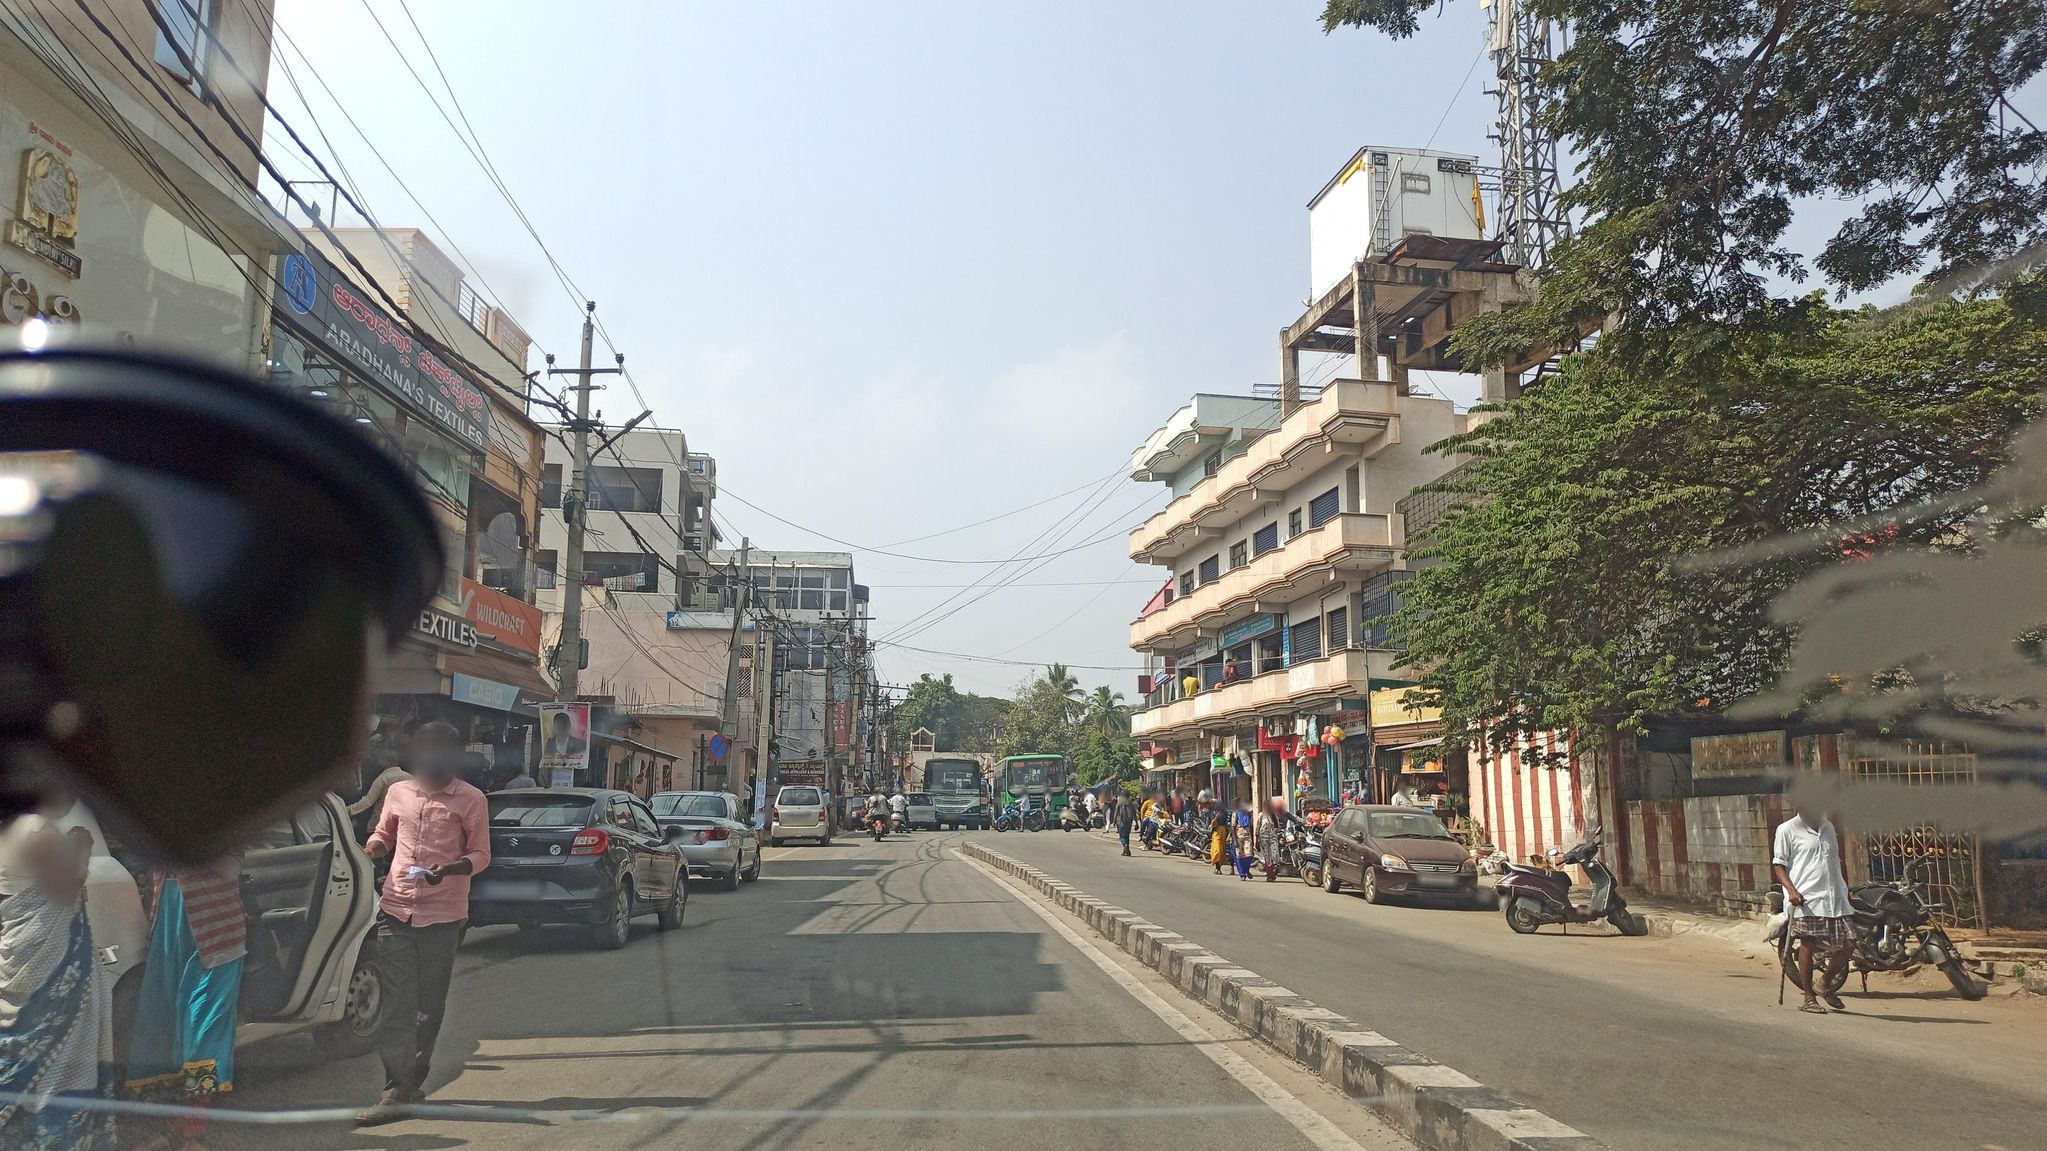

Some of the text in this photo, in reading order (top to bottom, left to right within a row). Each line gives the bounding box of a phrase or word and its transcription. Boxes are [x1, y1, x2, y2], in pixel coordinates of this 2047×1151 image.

[428, 396, 483, 446] TEXTILES
[413, 610, 478, 648] EXTILES
[476, 602, 525, 635] WILDCRAFT
